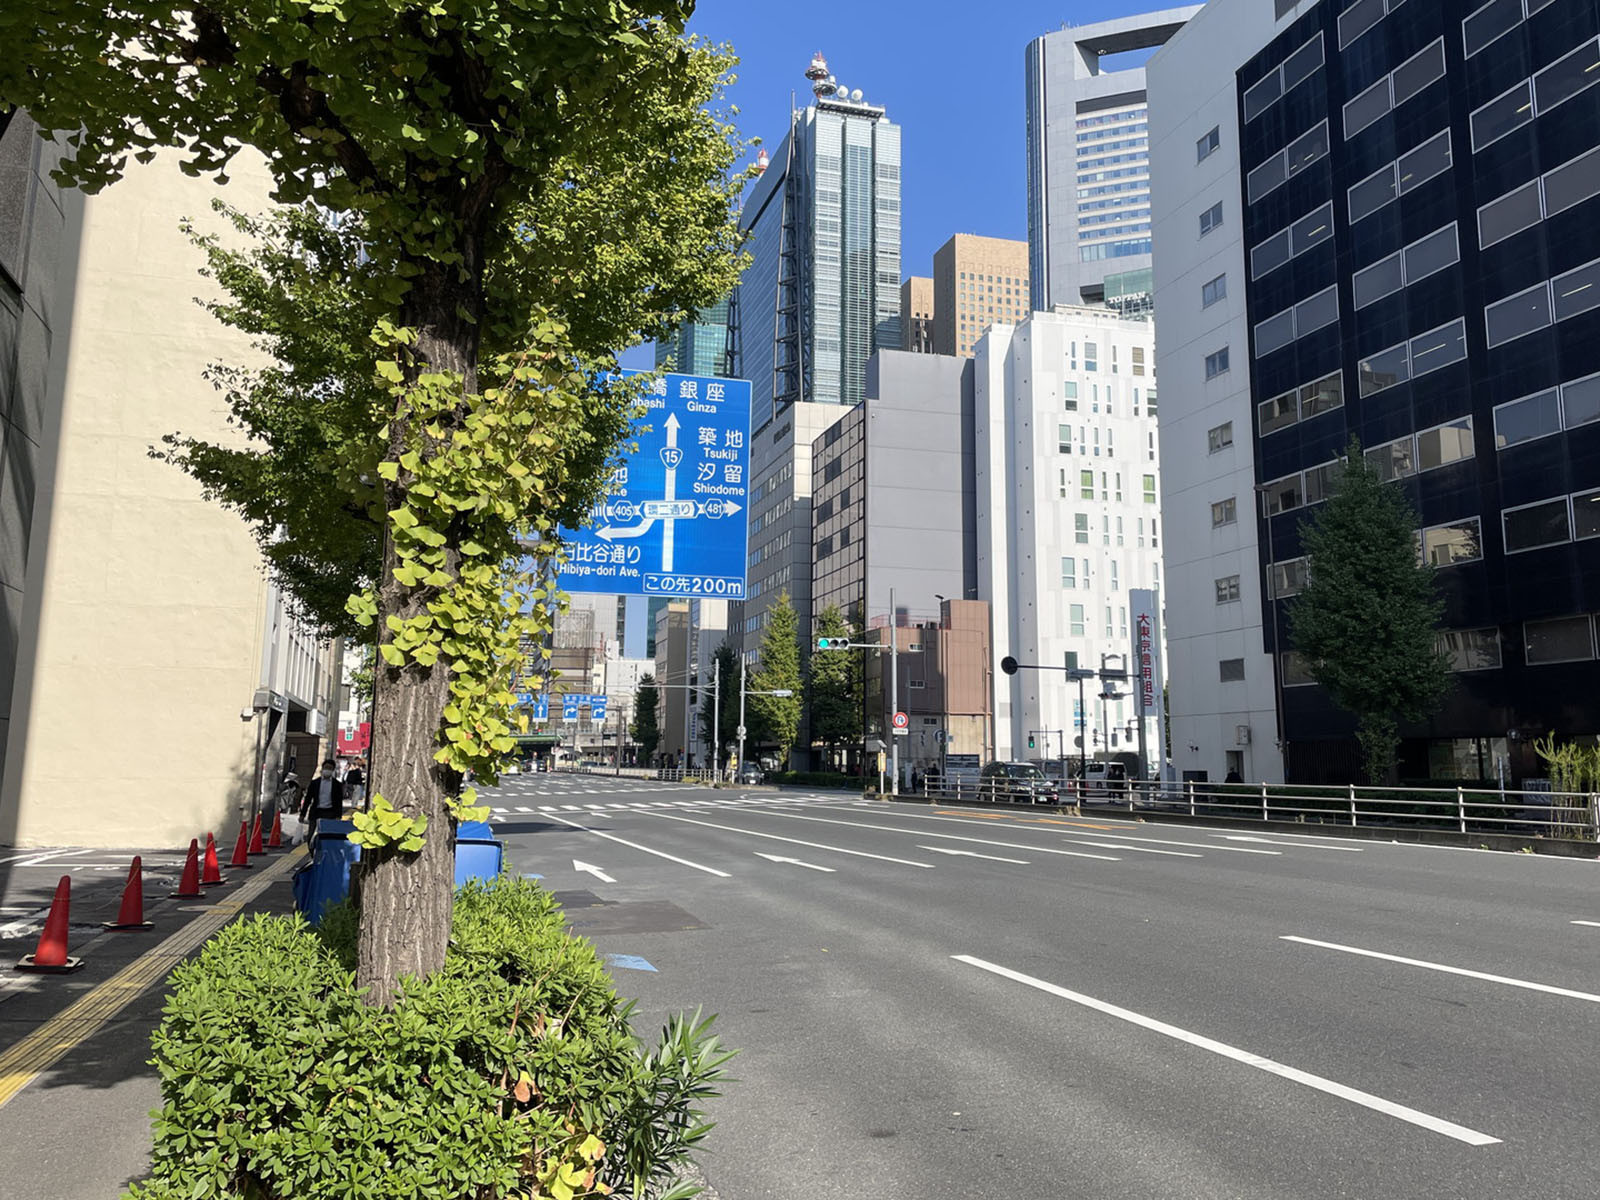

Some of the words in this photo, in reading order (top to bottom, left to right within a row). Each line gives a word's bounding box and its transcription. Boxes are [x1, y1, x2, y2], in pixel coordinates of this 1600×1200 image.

[680, 380, 725, 402] 銀座
[630, 396, 666, 409] nbashi
[687, 401, 717, 414] Ginza
[698, 427, 743, 448] 築地
[664, 450, 679, 463] 15
[703, 447, 738, 461] Tsukiji
[697, 462, 743, 483] 汐留
[693, 482, 745, 496] Shiodome
[615, 506, 632, 516] 405
[706, 503, 722, 514] 481
[560, 541, 641, 564] 日比谷通り
[559, 563, 616, 577] Hibiya-dori
[619, 566, 641, 577] Ave.
